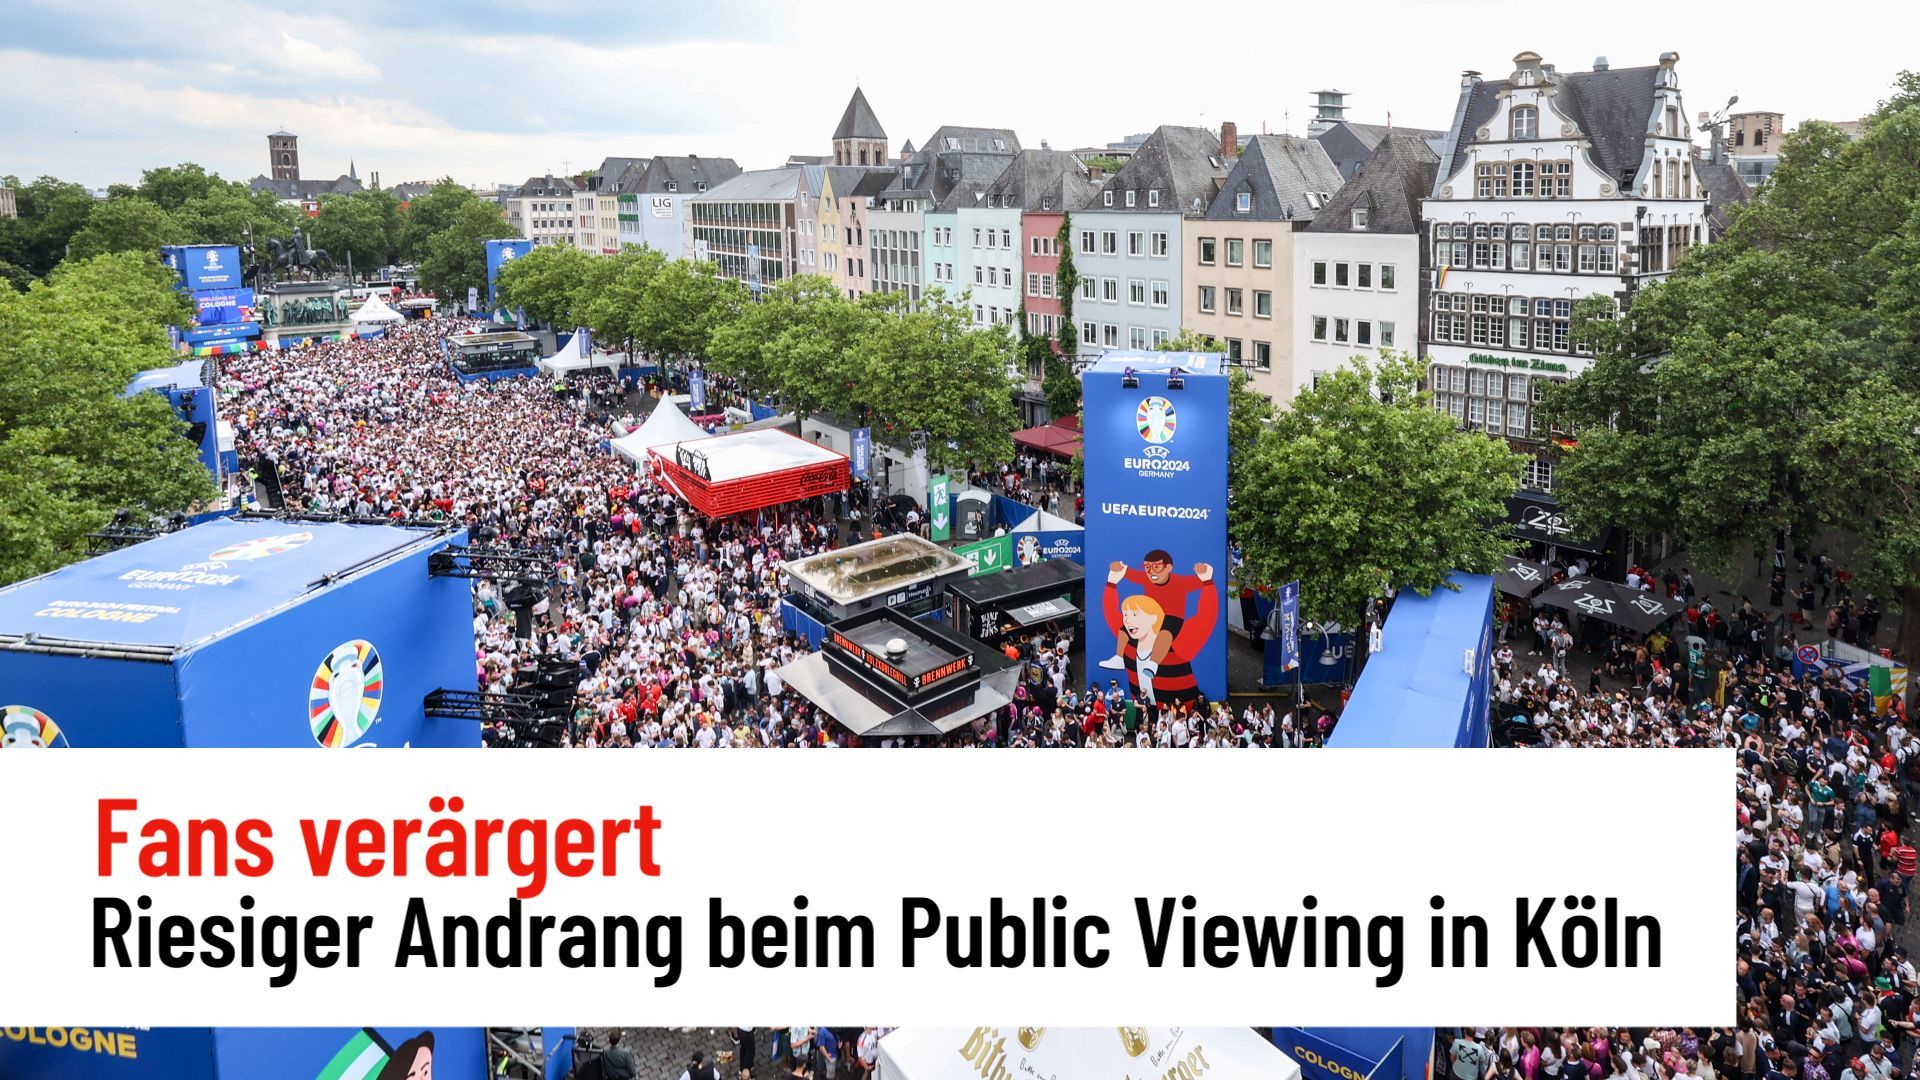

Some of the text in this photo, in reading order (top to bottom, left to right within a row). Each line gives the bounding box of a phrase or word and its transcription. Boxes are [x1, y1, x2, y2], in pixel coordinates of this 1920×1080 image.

[652, 198, 671, 208] LIG
[199, 300, 237, 309] COLOGNE
[1143, 445, 1171, 460] UEFA
[1124, 458, 1191, 472] EURO2024
[1138, 470, 1175, 479] GERMANY
[1043, 546, 1081, 554] EURO2024
[34, 606, 159, 624] COLOGNE
[833, 632, 862, 657] BRENNWERK
[866, 652, 908, 687] HOLZKOHLEGRILL
[921, 658, 967, 685] BRENNWERK
[0, 1027, 137, 1059] OLOGNE
[1294, 1045, 1367, 1080] COLOGN
